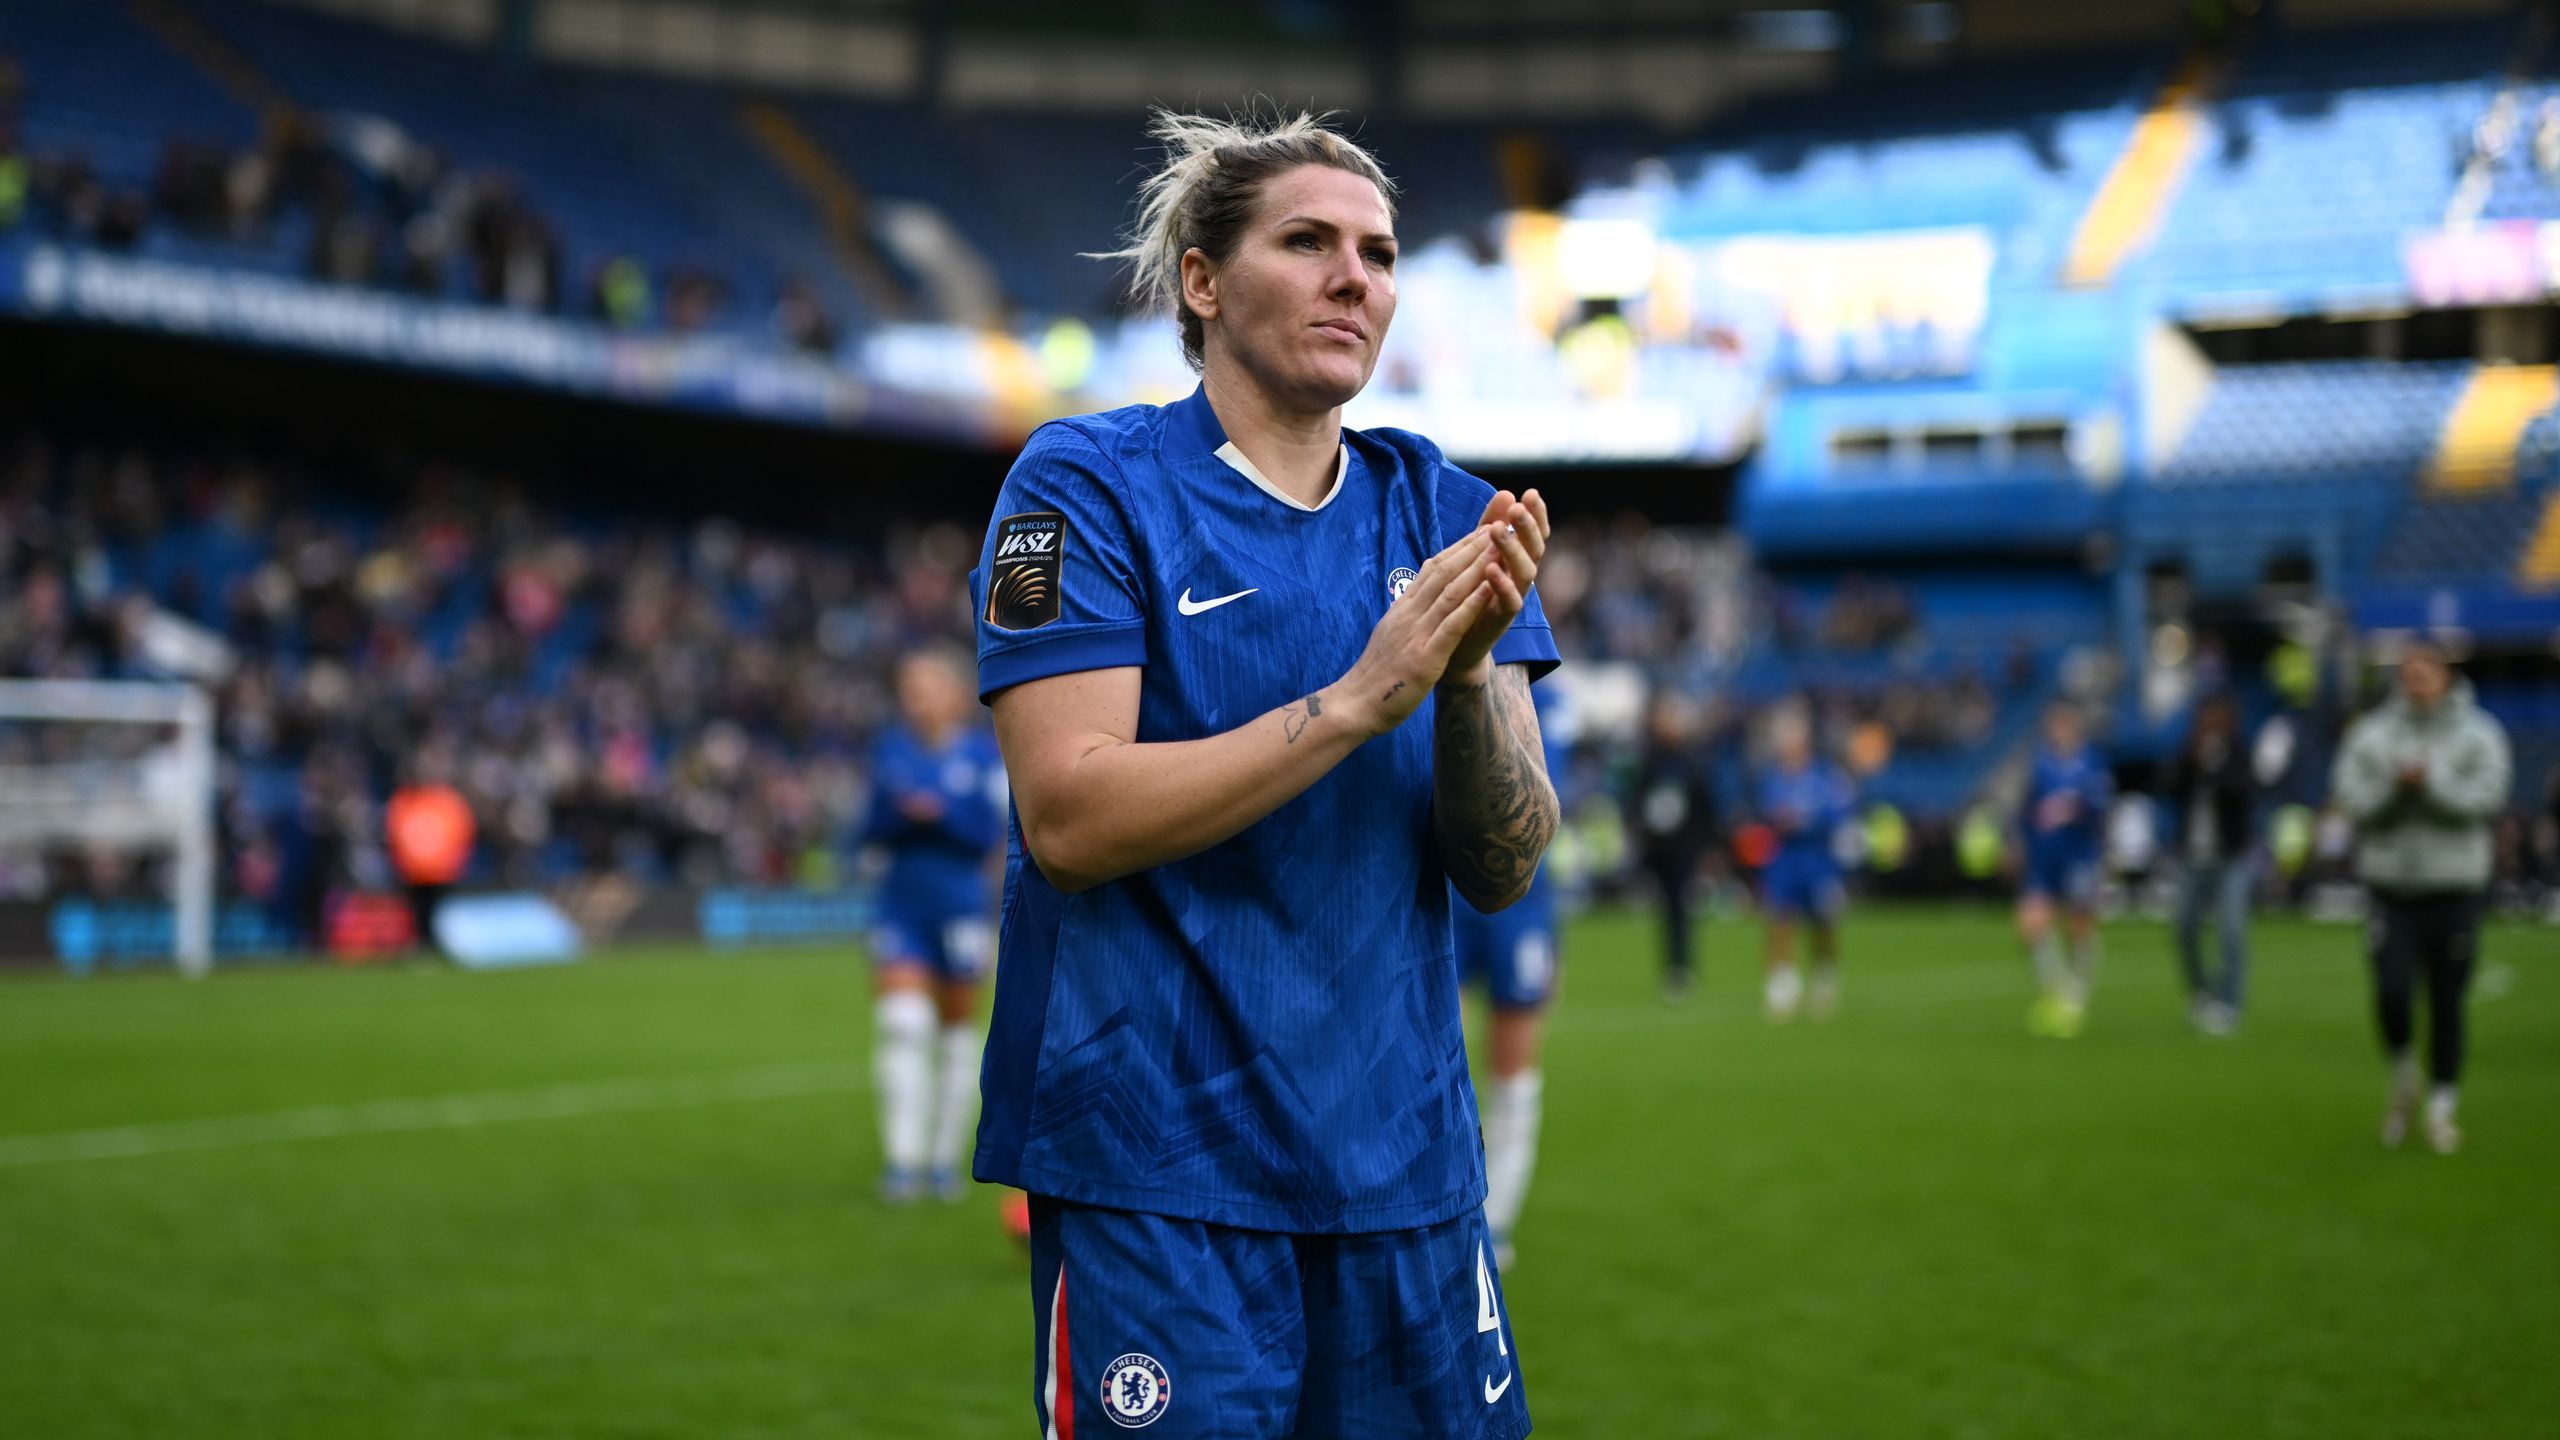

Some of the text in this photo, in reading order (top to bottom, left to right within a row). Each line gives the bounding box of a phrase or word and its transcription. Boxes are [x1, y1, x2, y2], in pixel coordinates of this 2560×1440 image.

[1016, 521, 1057, 531] BARCLAYS
[997, 532, 1056, 557] WSL
[995, 556, 1028, 566] CHAMPIONS
[1476, 1239, 1508, 1357] 4
[1111, 1356, 1156, 1373] CHELSEA
[1111, 1409, 1158, 1424] FOOTBALL CLUB
